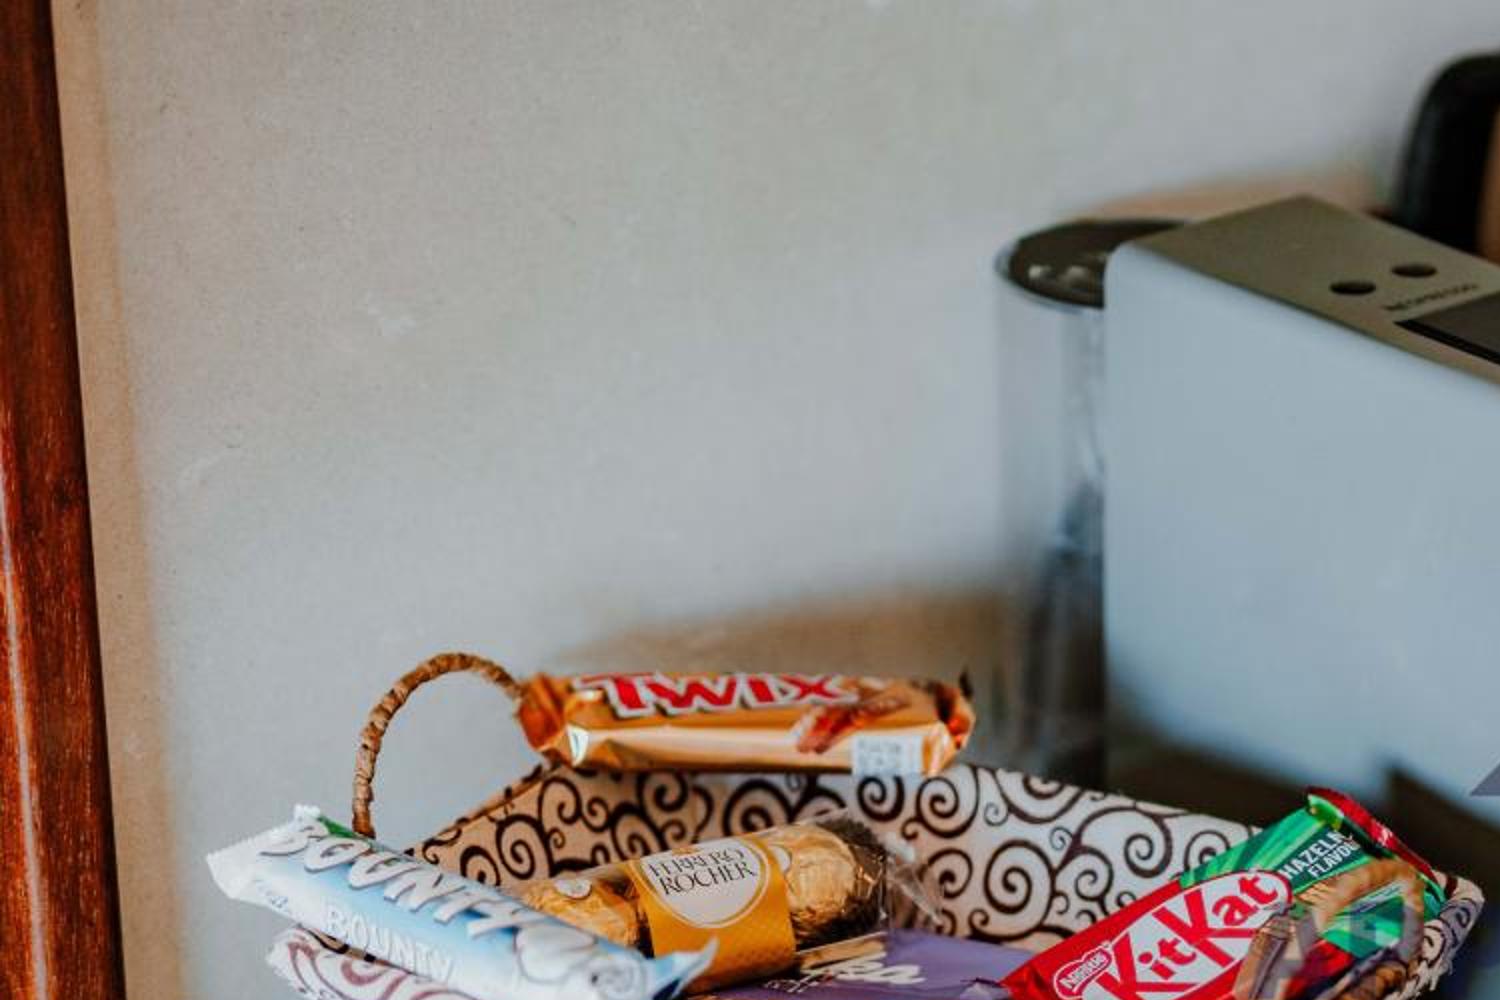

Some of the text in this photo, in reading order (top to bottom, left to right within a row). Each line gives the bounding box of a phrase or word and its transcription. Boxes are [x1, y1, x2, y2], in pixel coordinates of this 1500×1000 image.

[573, 672, 860, 718] TWIX
[649, 848, 745, 876] FERRERO
[659, 861, 757, 895] ROCHER
